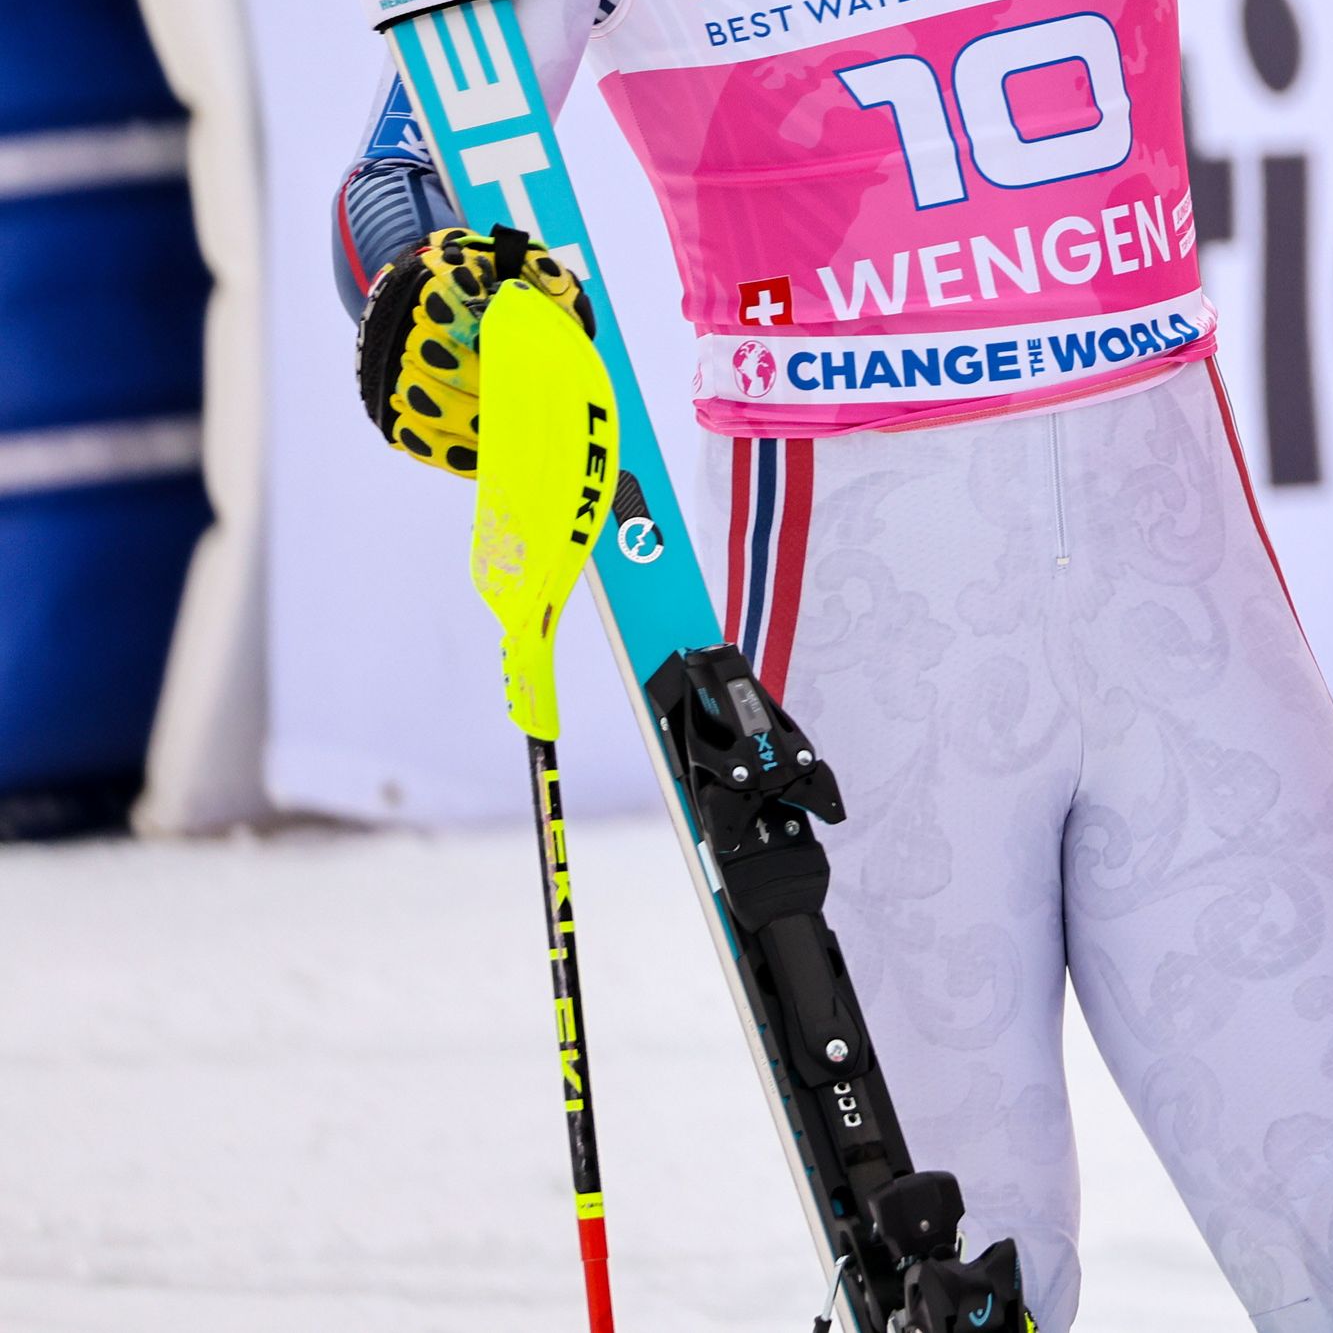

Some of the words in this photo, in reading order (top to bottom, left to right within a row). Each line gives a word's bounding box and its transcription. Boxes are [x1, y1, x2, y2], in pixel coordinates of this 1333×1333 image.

[706, 5, 793, 47] BEST
[833, 11, 1133, 211] 10
[816, 195, 1172, 321] WENGEN
[786, 346, 1024, 392] CHANGE
[1028, 337, 1046, 377] THE
[569, 401, 609, 546] LEKI
